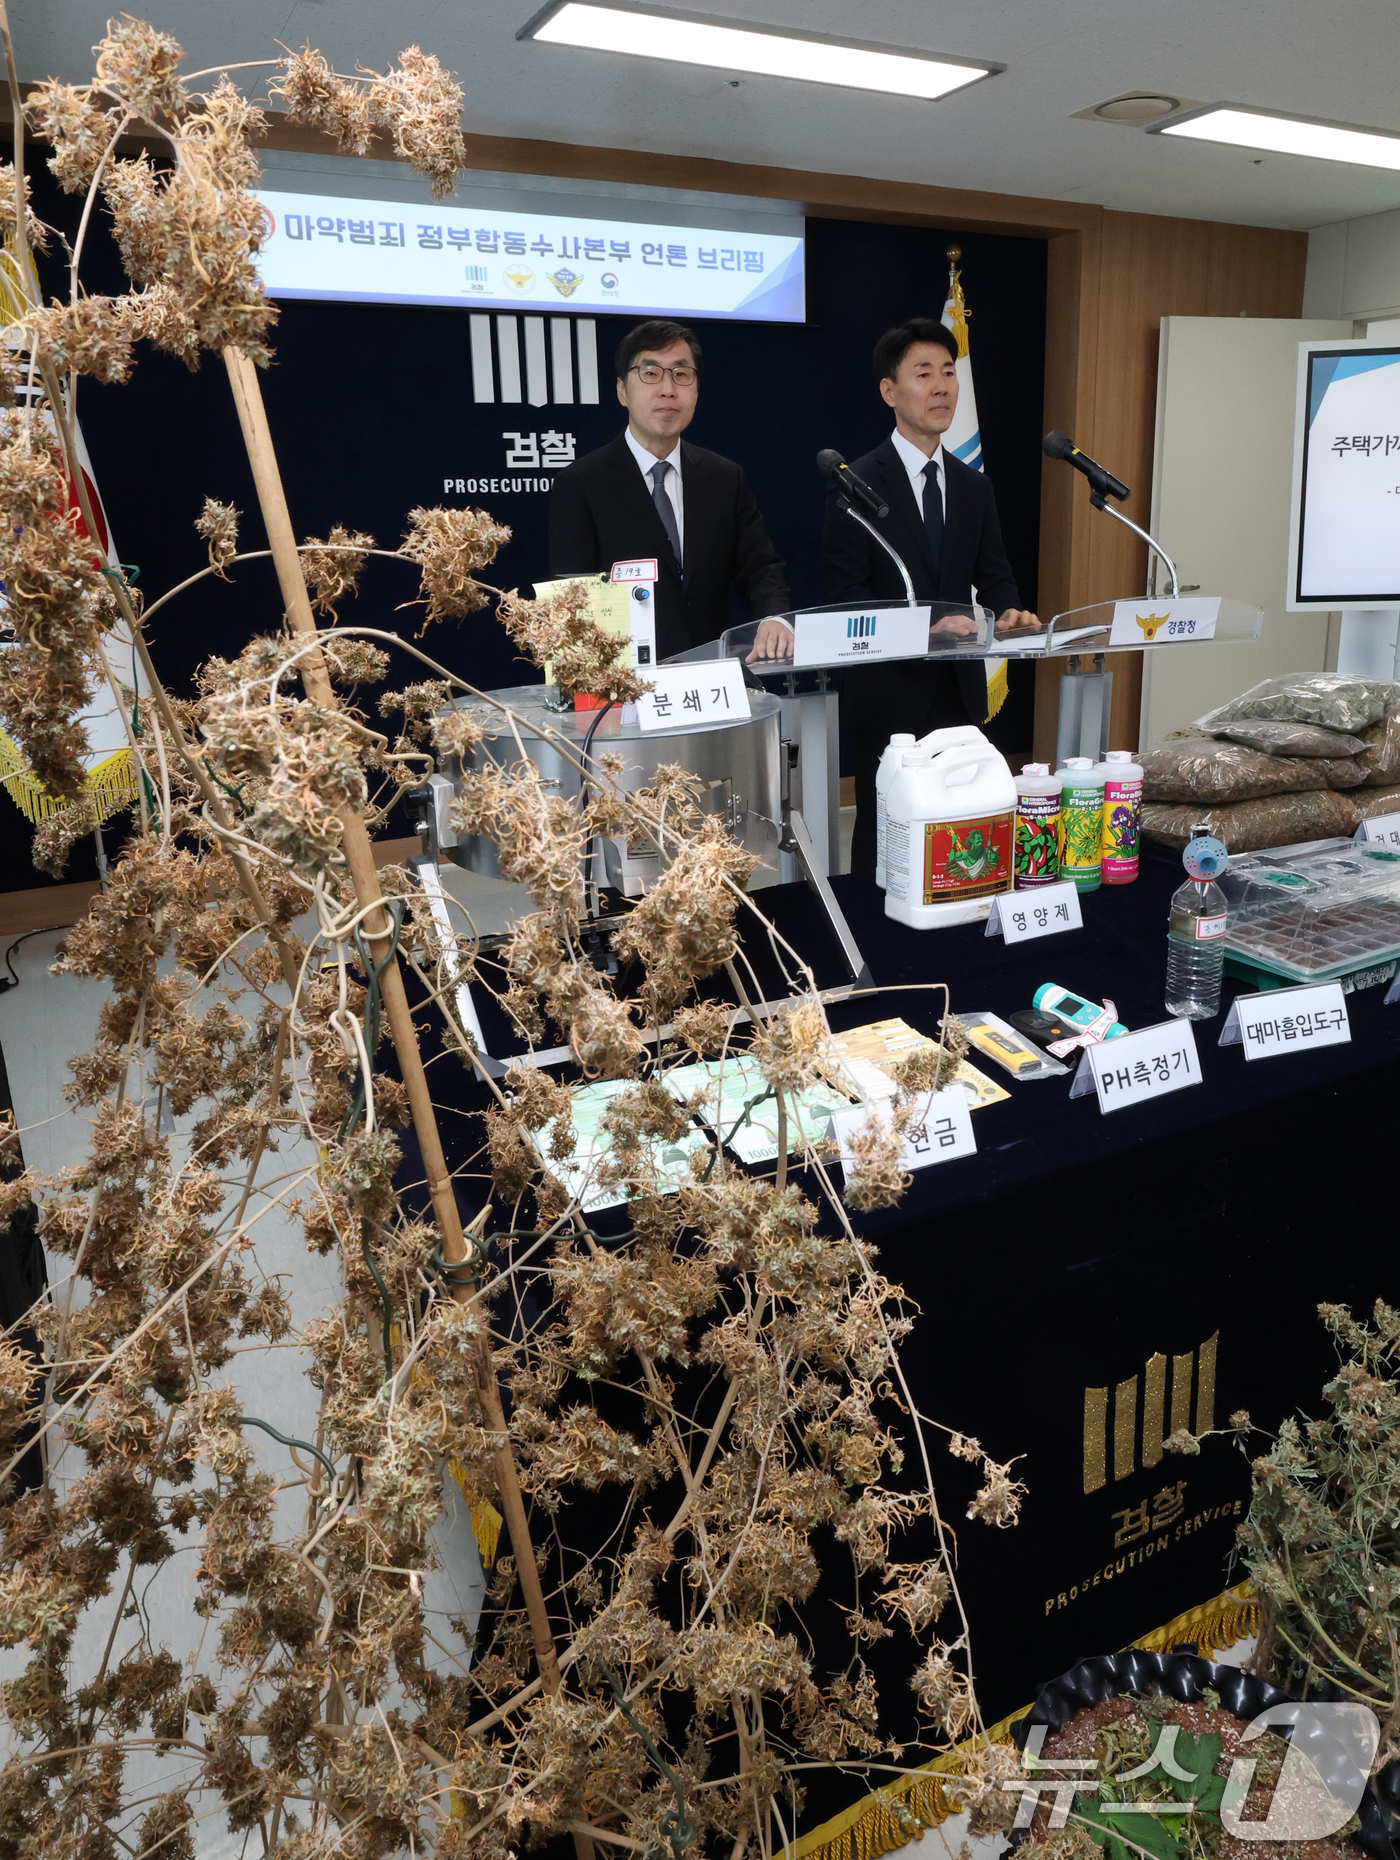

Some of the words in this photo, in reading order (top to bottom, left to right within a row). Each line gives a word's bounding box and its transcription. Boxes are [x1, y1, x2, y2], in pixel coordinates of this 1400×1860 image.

[284, 214, 405, 247] 마약범죄
[416, 223, 632, 263] 정부합동수사본부
[641, 242, 688, 268] 언론
[697, 247, 765, 273] 브리핑
[502, 429, 577, 468] 검찰
[443, 478, 555, 493] PROSECUTIO
[852, 641, 869, 650] 검찰
[1167, 620, 1196, 635] 경찰청
[1246, 1007, 1347, 1045] 대마흡입도구
[1101, 1048, 1190, 1094] PH측정기
[1111, 1480, 1188, 1549] 검찰
[1045, 1534, 1170, 1616] PROSECUTION
[1174, 1499, 1243, 1542] SERVICE
